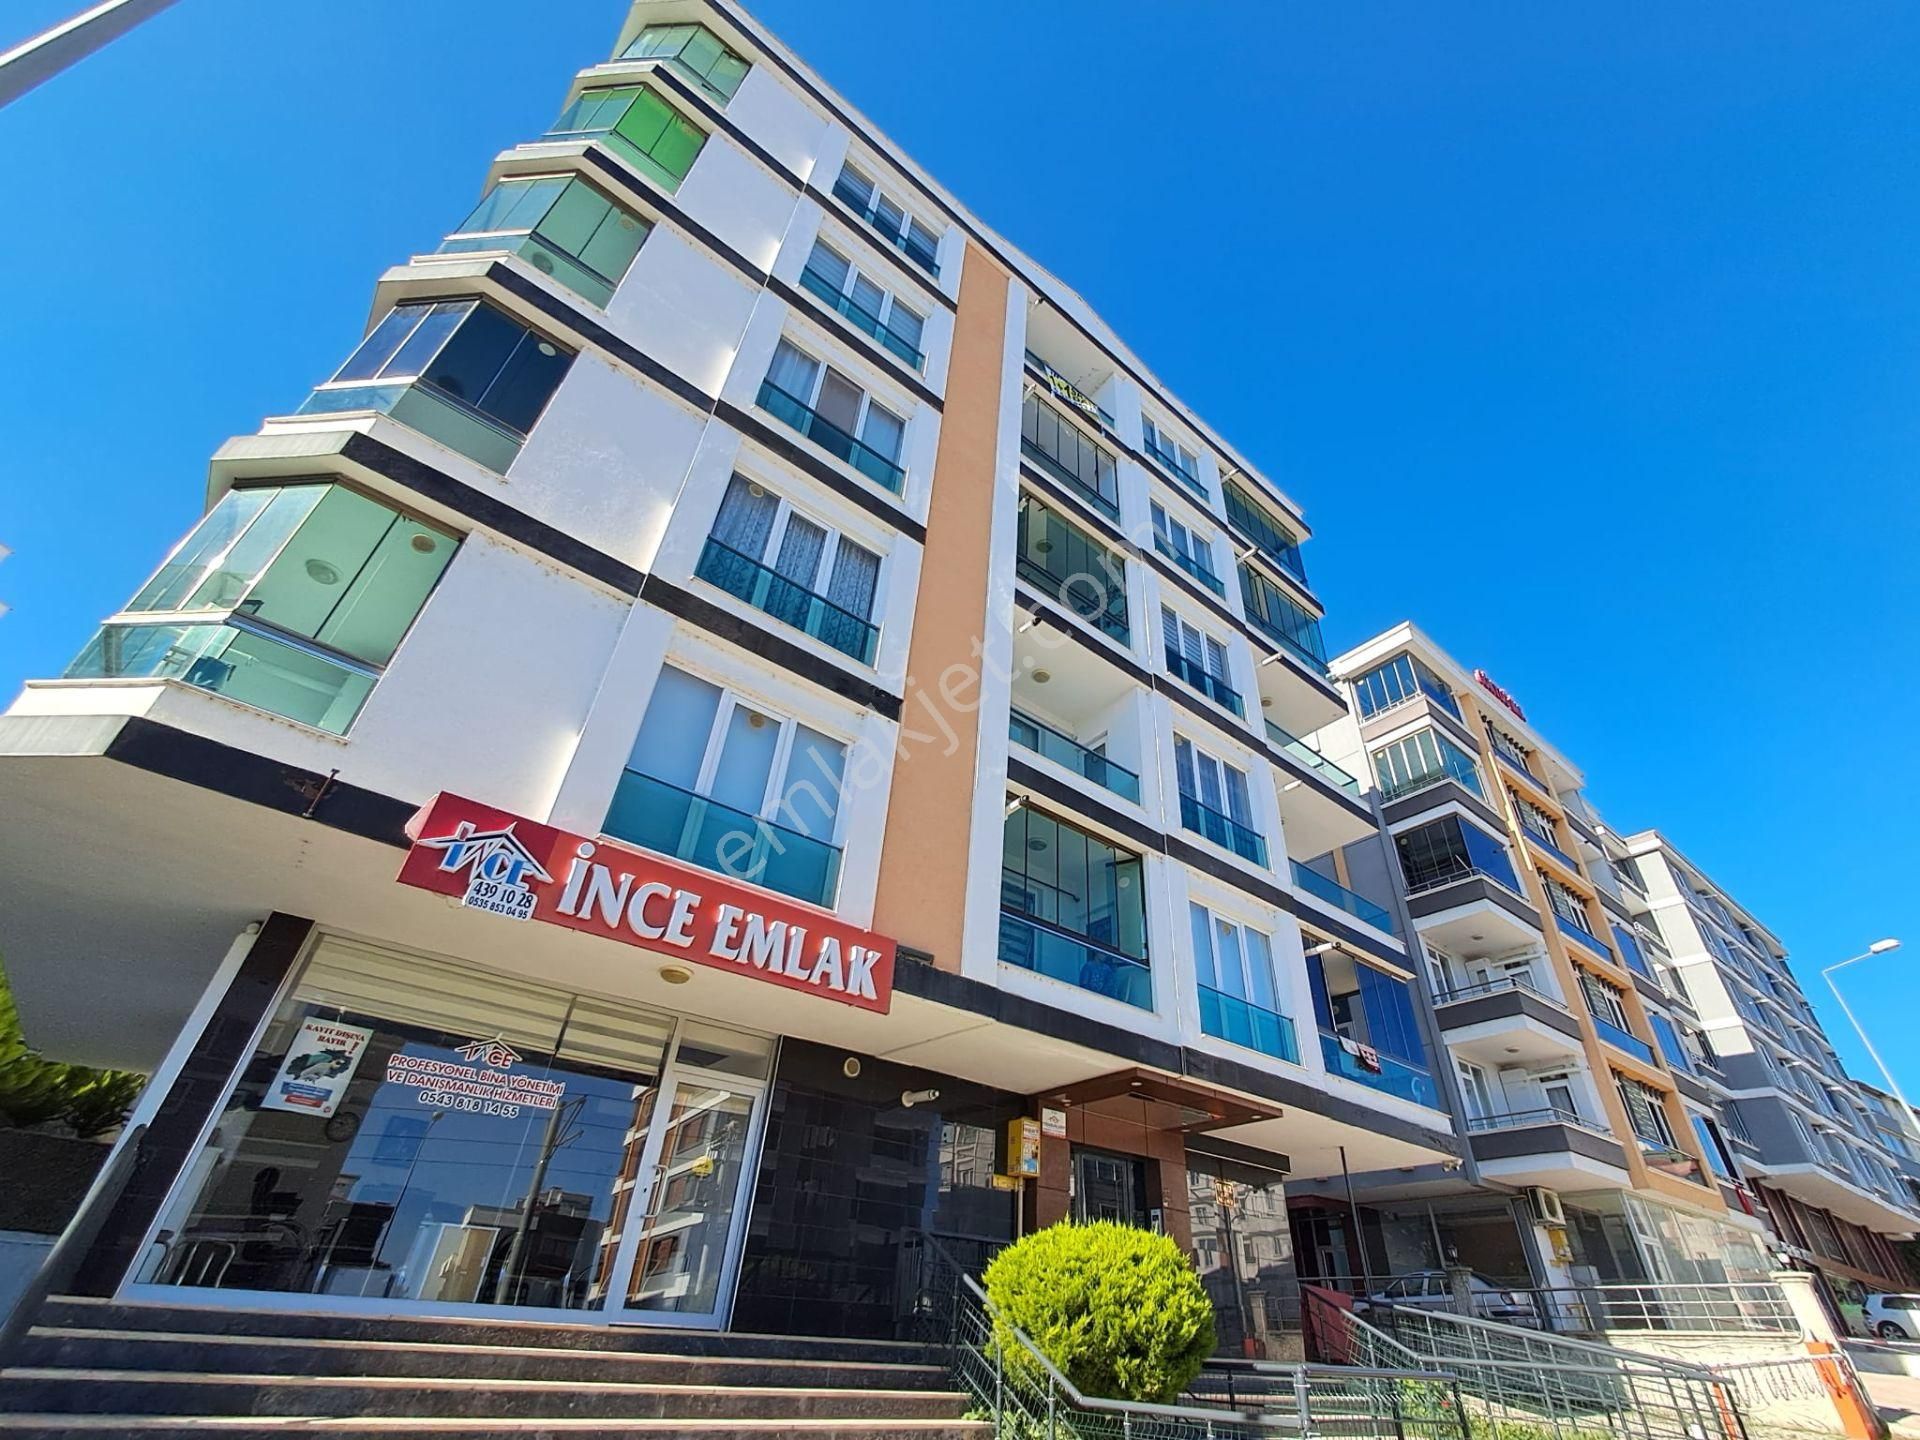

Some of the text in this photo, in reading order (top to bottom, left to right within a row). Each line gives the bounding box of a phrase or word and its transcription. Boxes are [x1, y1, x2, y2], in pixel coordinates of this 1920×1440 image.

[468, 896, 528, 919] 0535 853 04 95
[472, 881, 534, 909] 439 10 28
[555, 841, 883, 1001] İNCE EMLAK
[304, 1023, 335, 1037] KAYIT
[388, 1054, 566, 1096] PROFESYONEL BİNA YÖNETİMİ
[387, 1070, 405, 1083] VE
[492, 1087, 559, 1109] HİZMETLERİ
[419, 1091, 519, 1118] 0543 818 14 55
